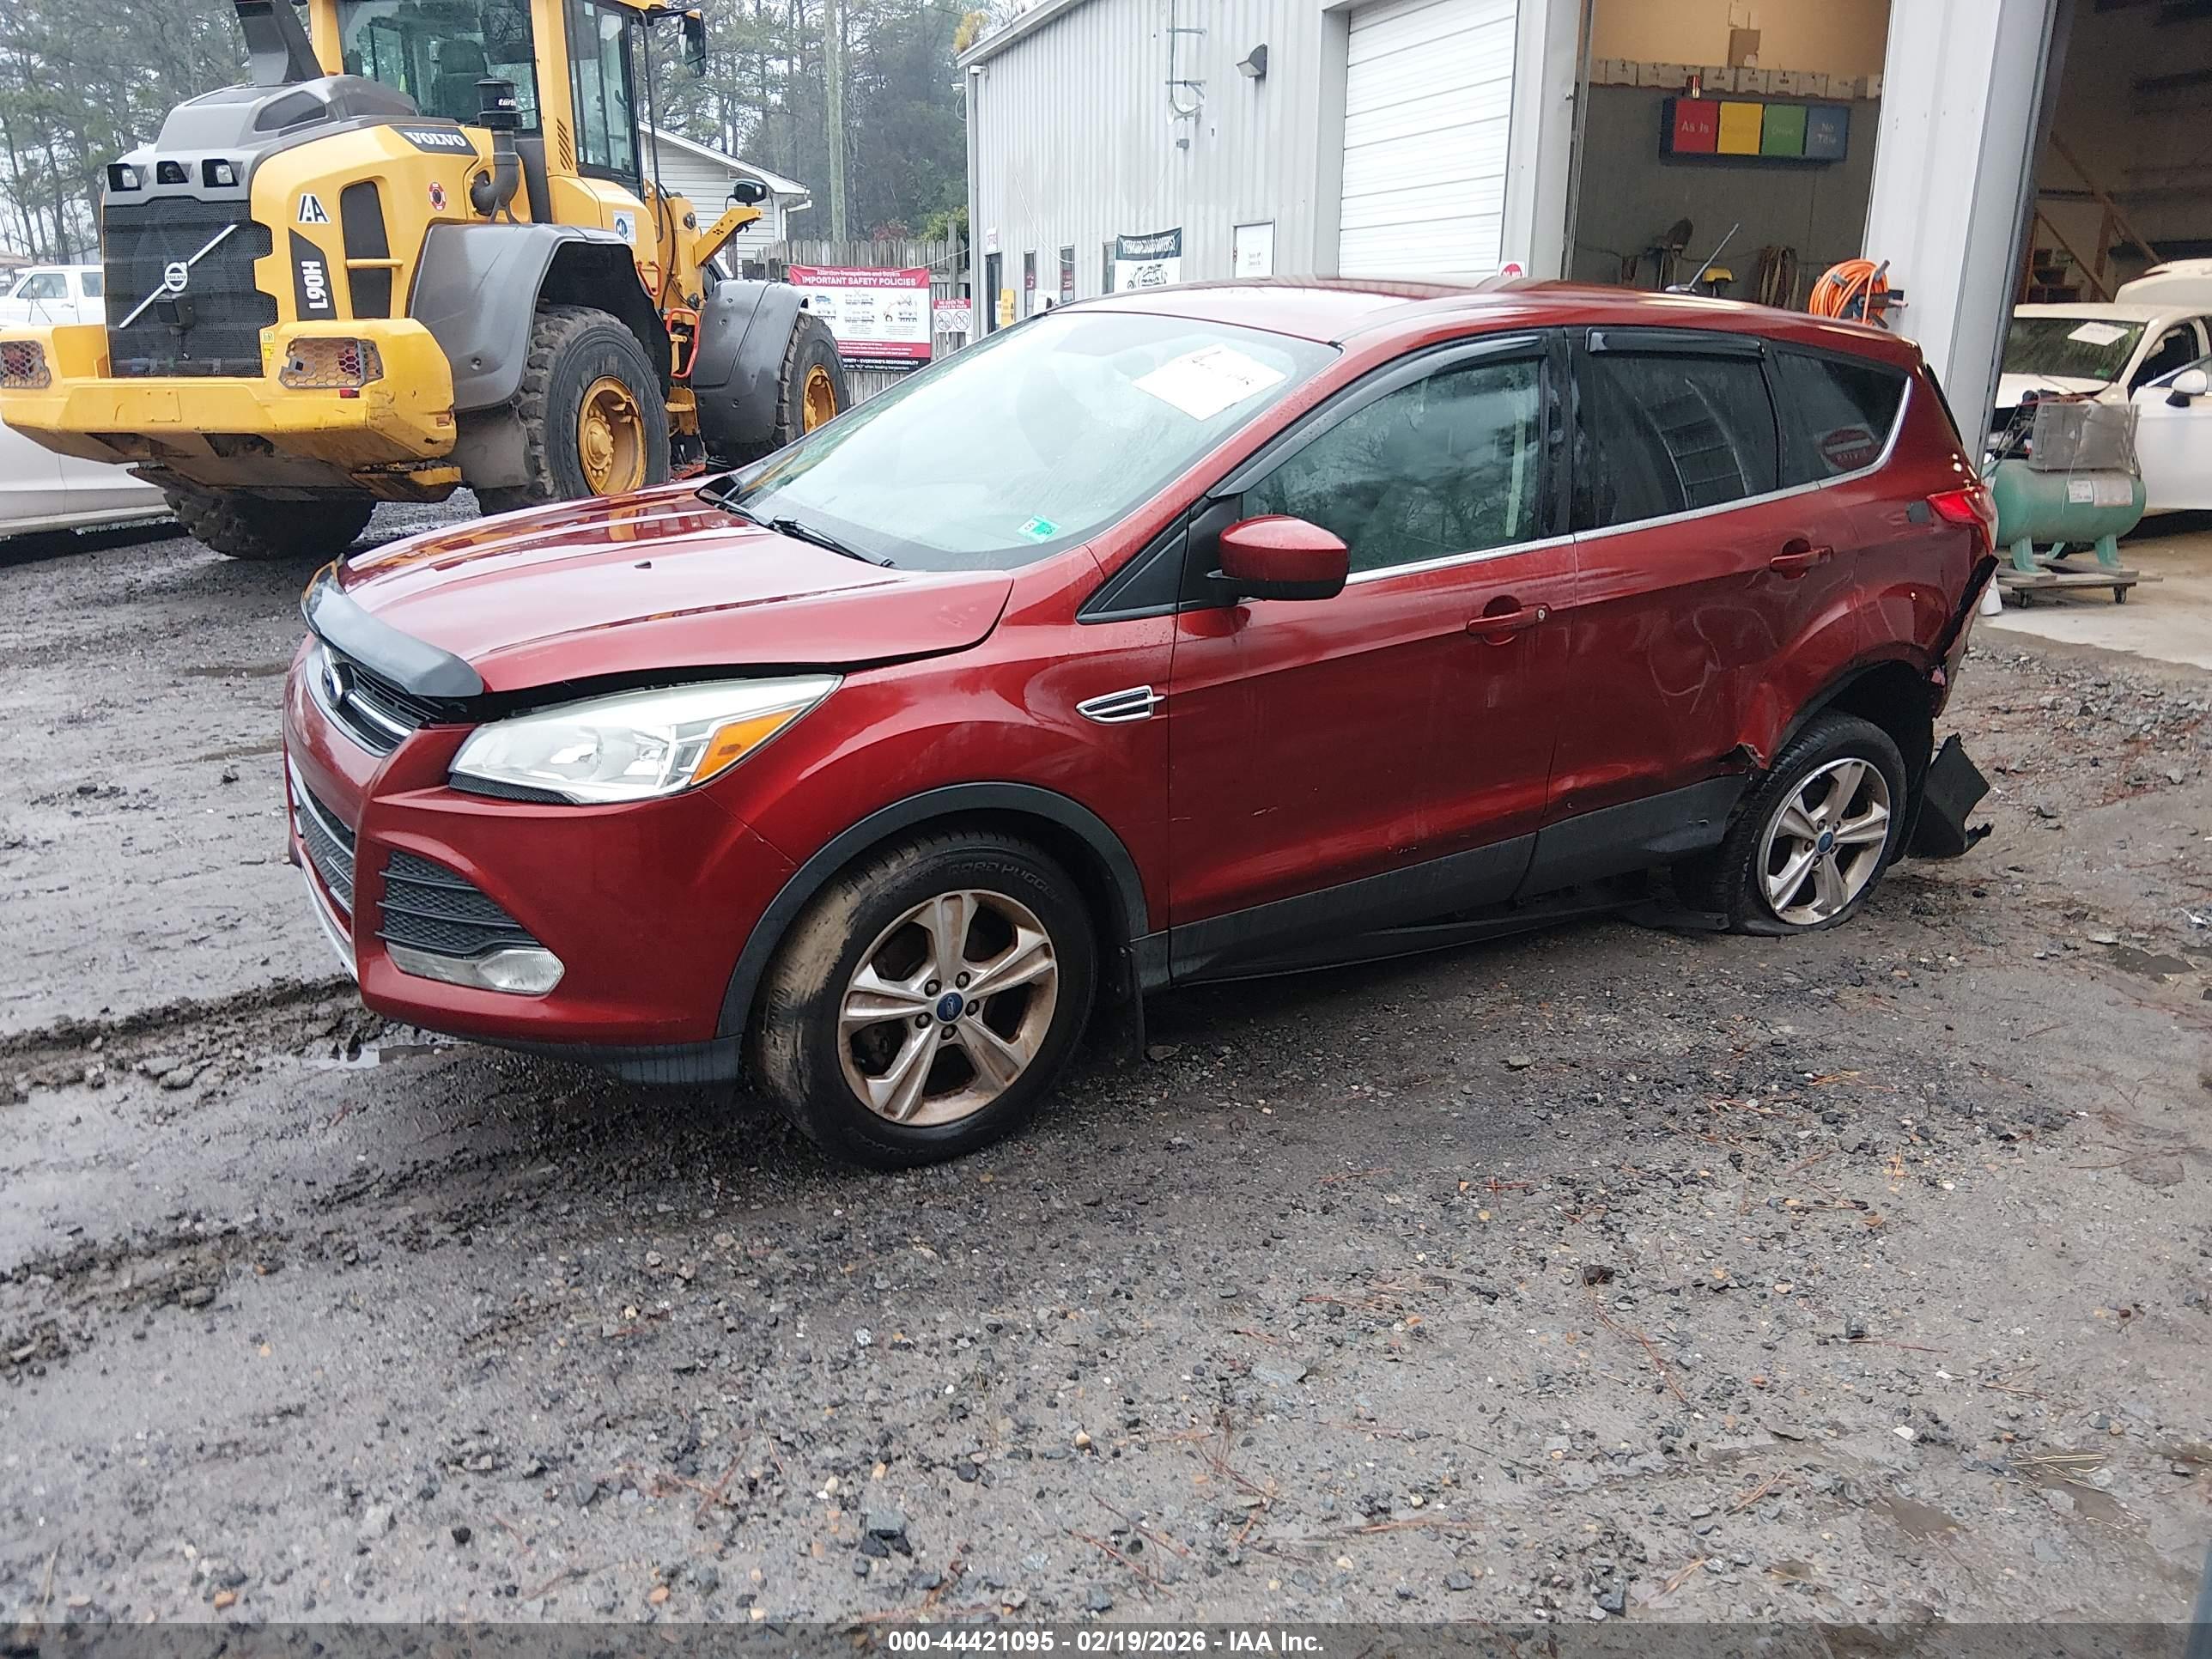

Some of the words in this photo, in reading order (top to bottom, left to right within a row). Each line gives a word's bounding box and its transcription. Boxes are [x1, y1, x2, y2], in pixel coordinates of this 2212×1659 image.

[1681, 121, 1695, 132] As
[1699, 123, 1710, 133] Is
[404, 131, 467, 147] VOLVO
[301, 260, 329, 309] L90H
[802, 276, 848, 285] IMPORTANT
[848, 277, 878, 286] SAFETY
[879, 277, 916, 286] POLICIES
